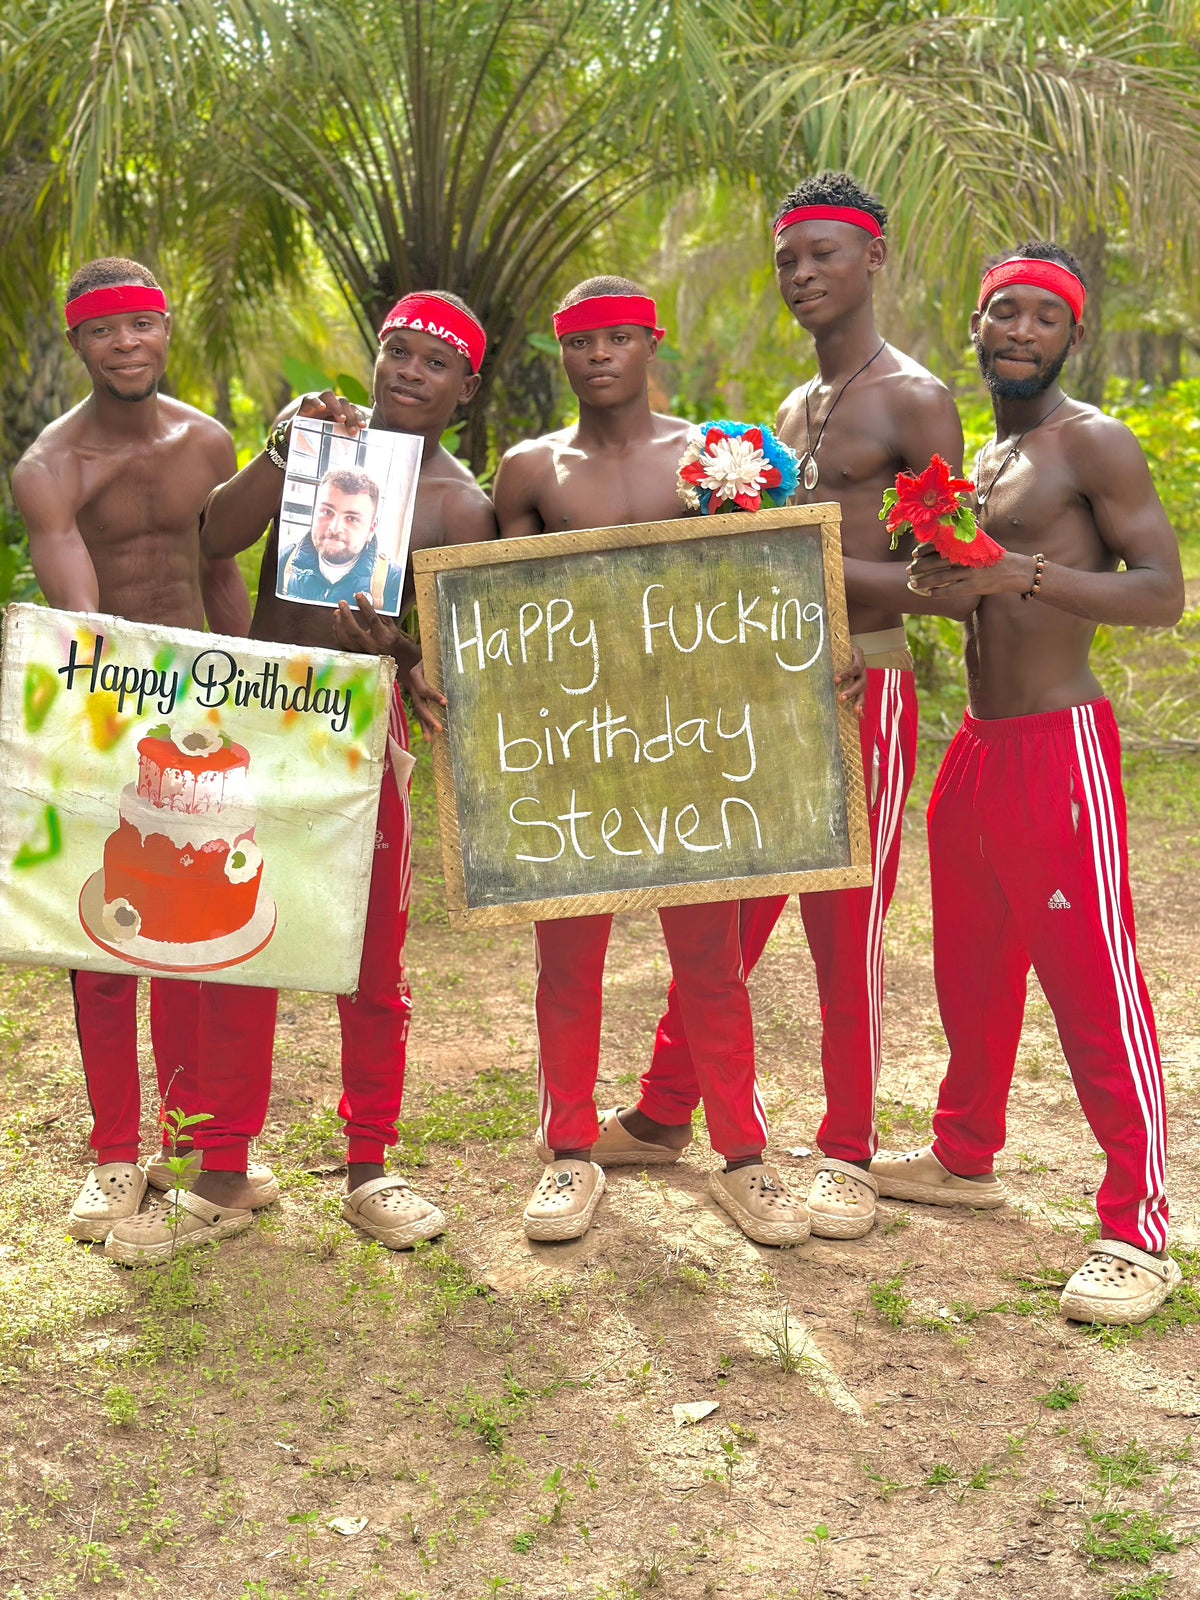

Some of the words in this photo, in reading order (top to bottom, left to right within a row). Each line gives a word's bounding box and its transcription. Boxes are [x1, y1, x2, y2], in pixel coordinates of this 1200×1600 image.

[267, 447, 287, 470] WISDO
[641, 583, 825, 672] fucking
[58, 635, 178, 715] Happy
[191, 649, 352, 733] Birthday
[496, 694, 757, 782] birthday
[508, 788, 763, 862] Steven
[1047, 901, 1071, 910] sports
